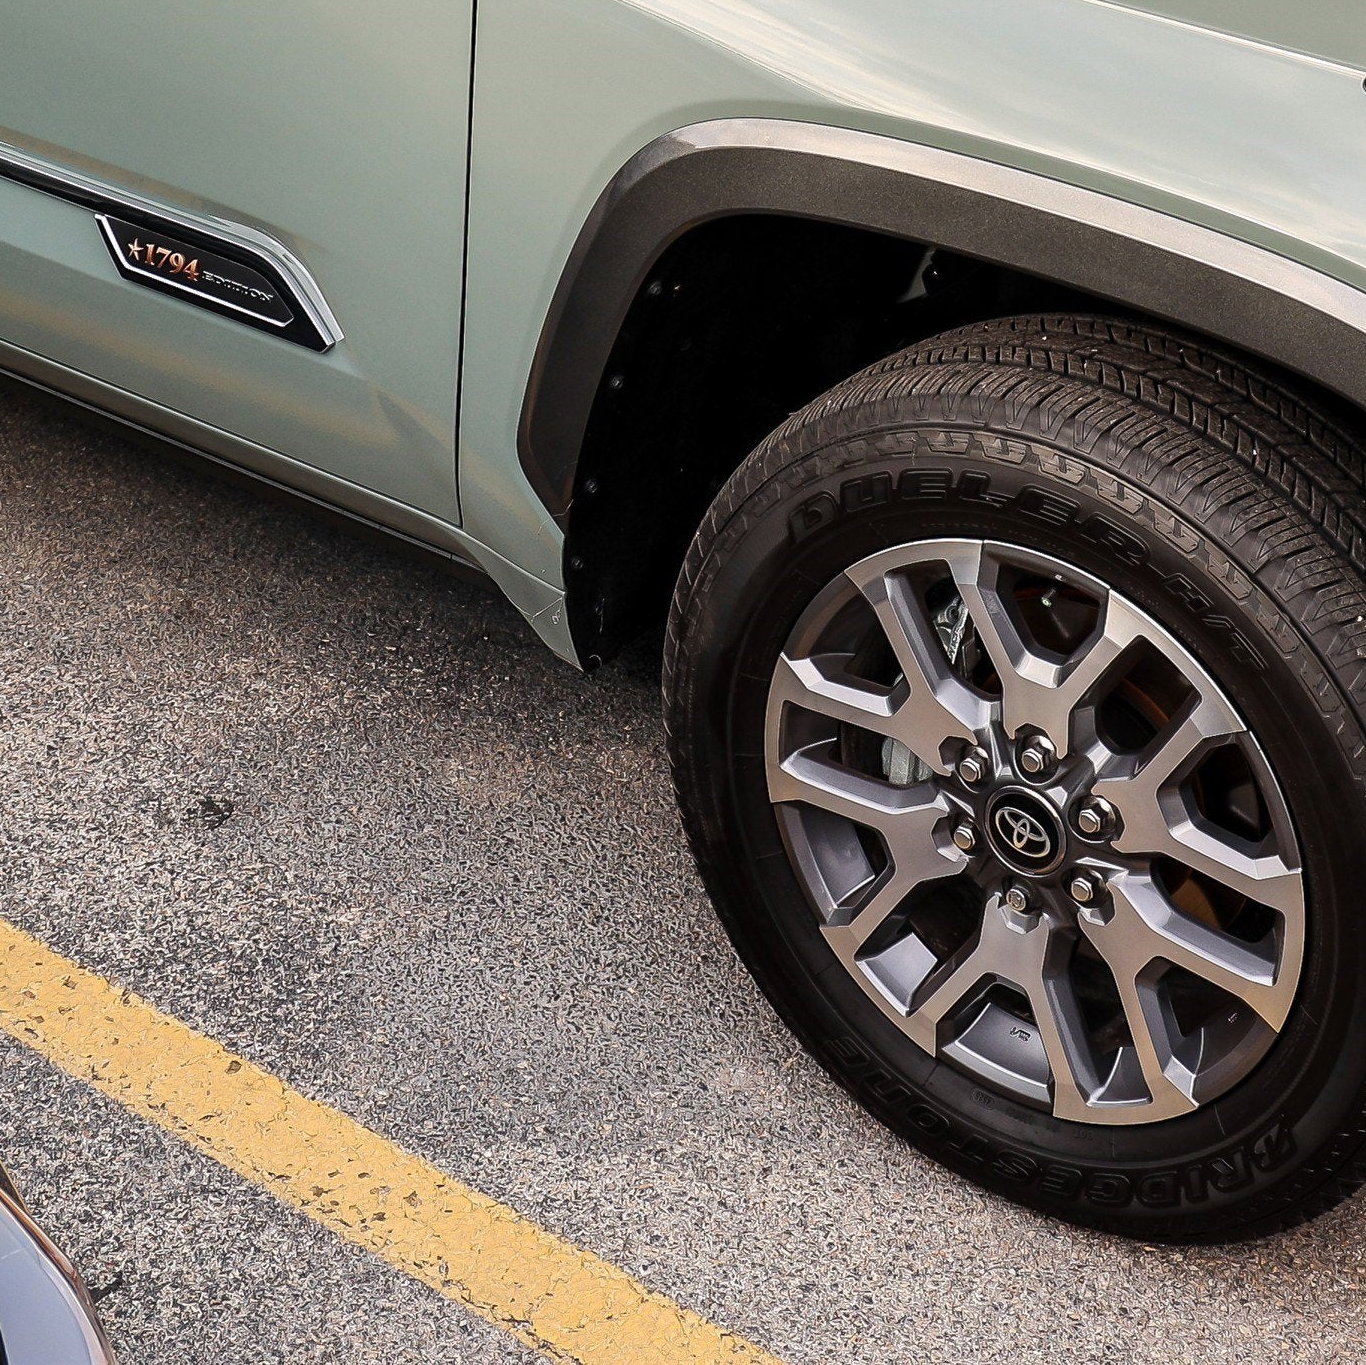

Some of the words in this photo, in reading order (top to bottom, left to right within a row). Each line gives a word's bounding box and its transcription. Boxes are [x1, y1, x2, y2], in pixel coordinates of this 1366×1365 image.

[145, 243, 201, 282] 1794
[201, 270, 274, 304] EDITION
[787, 466, 1152, 565] DUELER
[820, 1033, 1300, 1211] BRIDGESTONE
